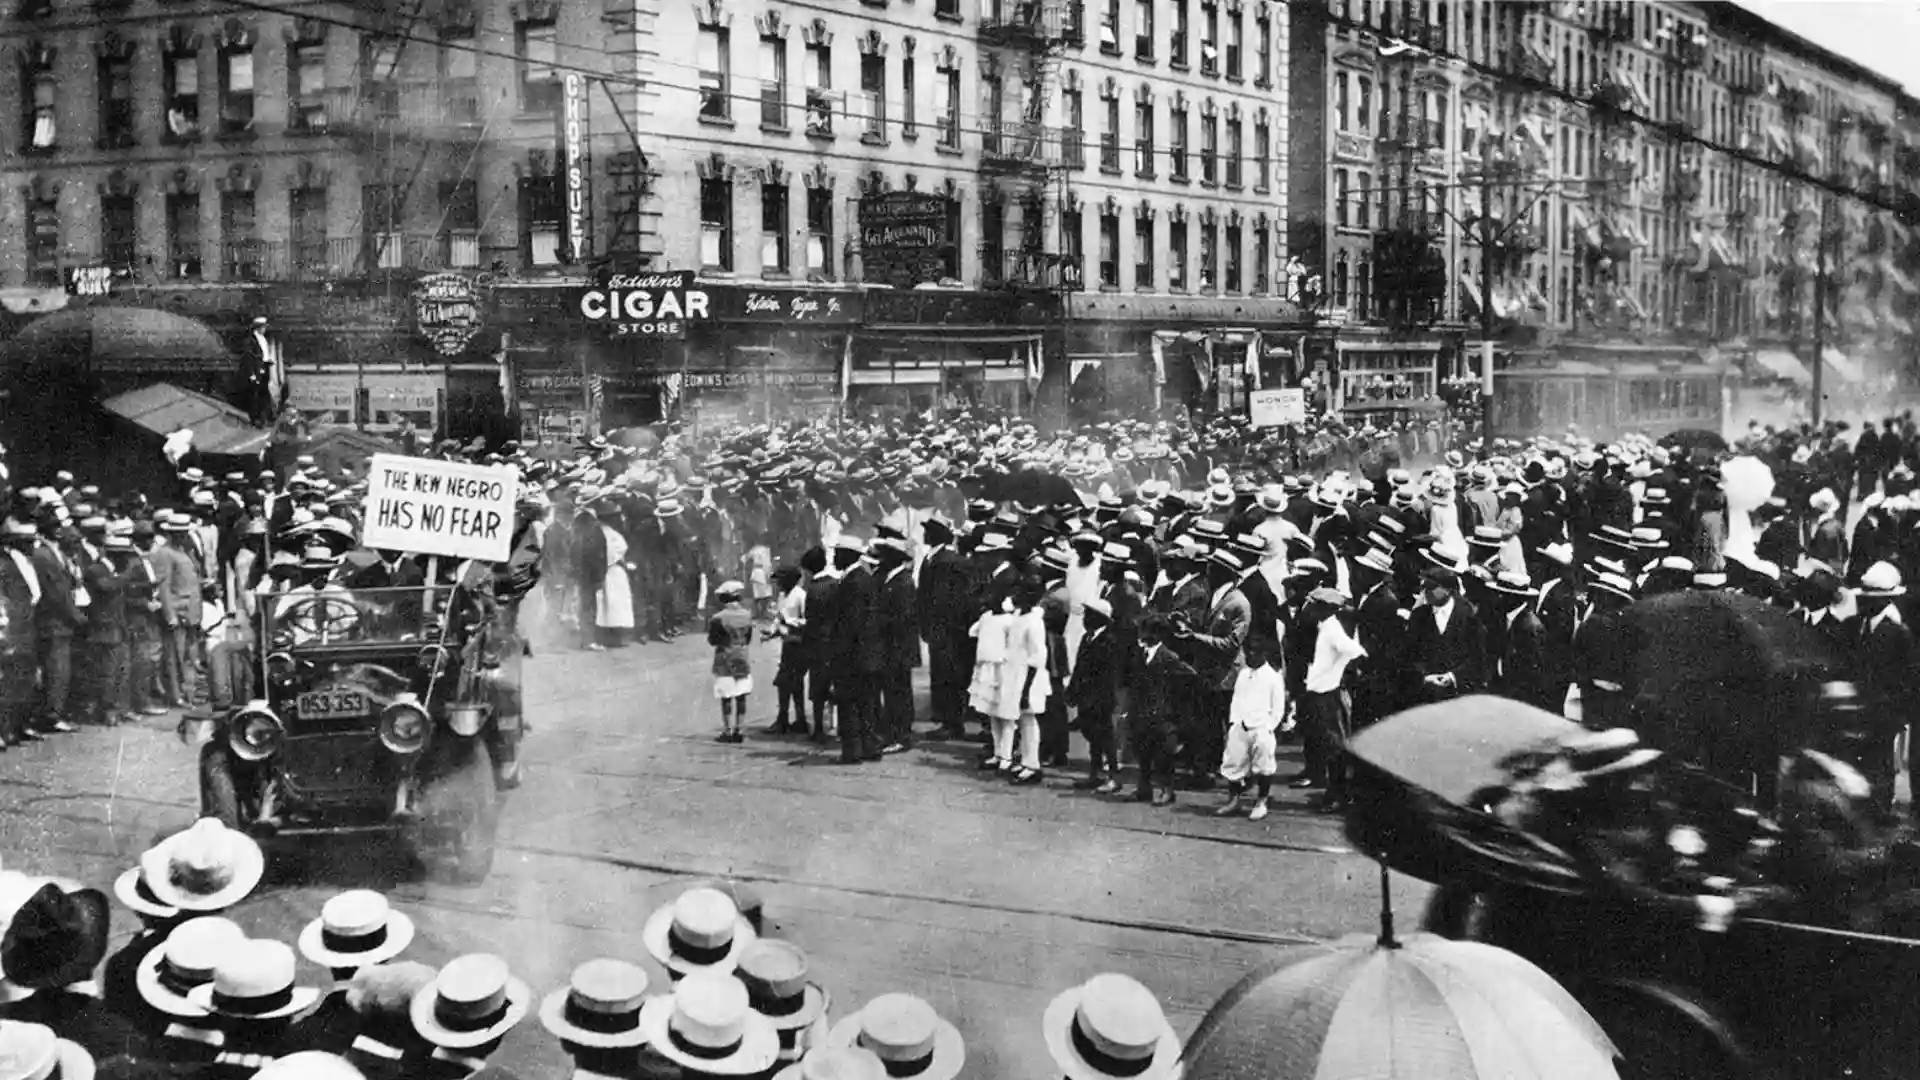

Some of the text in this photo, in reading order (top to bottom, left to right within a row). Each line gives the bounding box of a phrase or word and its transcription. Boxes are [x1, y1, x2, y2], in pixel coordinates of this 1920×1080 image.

[566, 74, 583, 259] CHOP SUEY
[580, 290, 709, 320] CIGAR
[618, 322, 681, 334] STORE
[384, 469, 503, 501] THE NEW NEGRO
[378, 498, 501, 540] HAS NO FEAR
